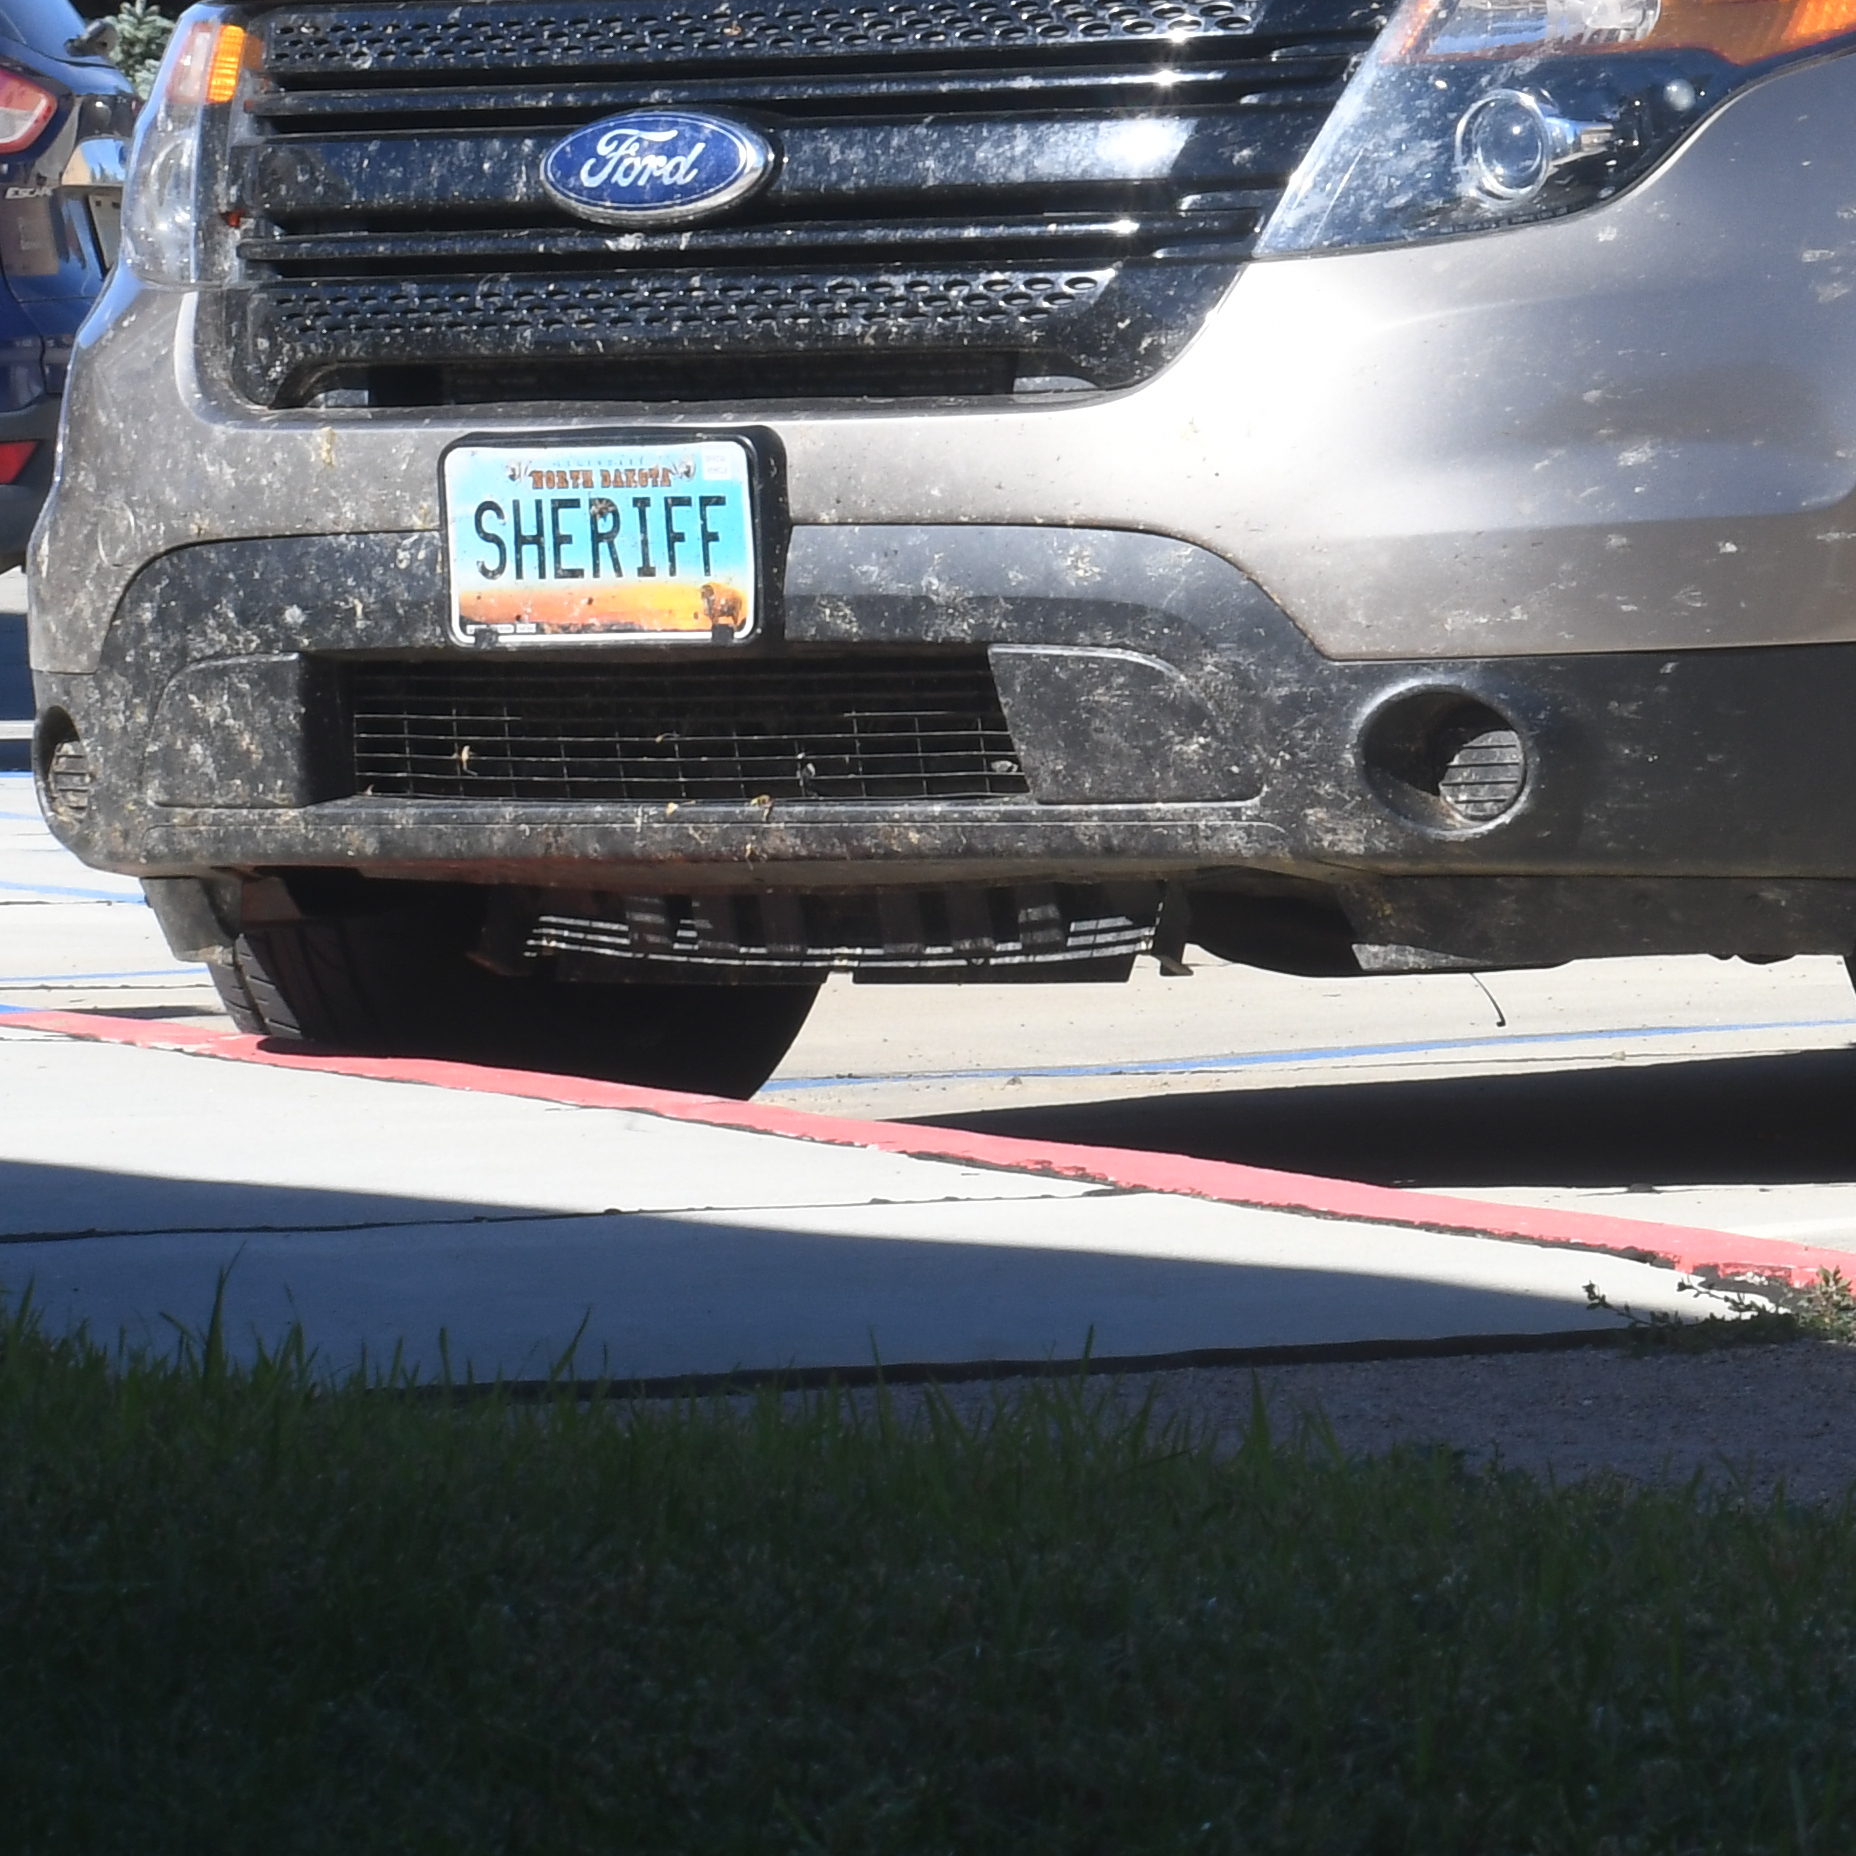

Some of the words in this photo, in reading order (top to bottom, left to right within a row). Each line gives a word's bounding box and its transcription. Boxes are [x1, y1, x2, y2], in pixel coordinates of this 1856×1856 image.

[580, 128, 706, 188] Ford
[528, 469, 594, 490] NORTH
[600, 466, 675, 489] DAKOTA
[473, 495, 727, 581] SHERIFF
